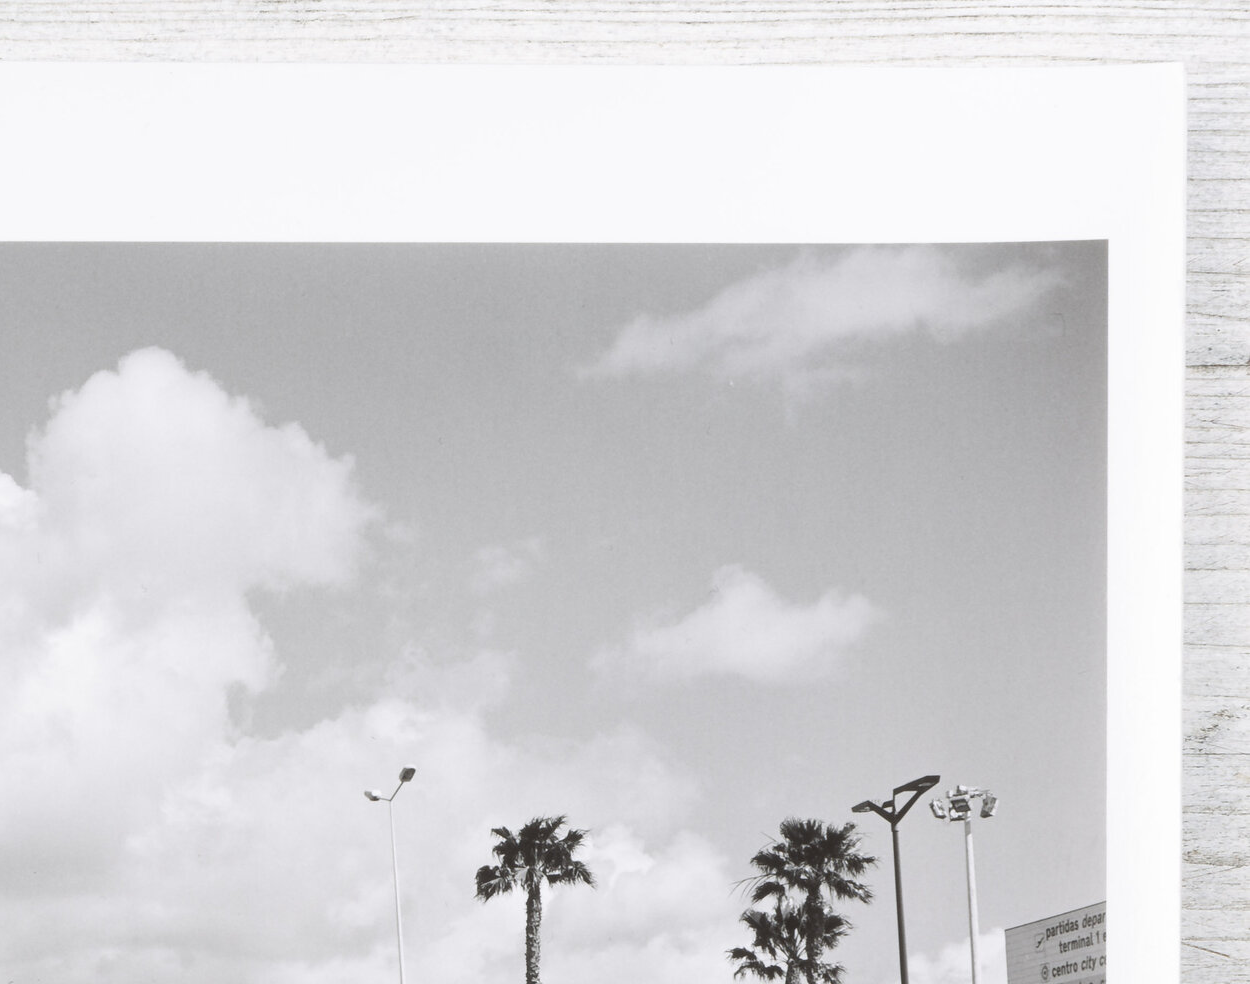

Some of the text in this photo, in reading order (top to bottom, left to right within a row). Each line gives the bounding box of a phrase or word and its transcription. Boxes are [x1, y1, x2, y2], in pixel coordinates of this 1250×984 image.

[1046, 919, 1079, 941] partidas
[1059, 932, 1093, 953] terminal
[1096, 931, 1100, 944] 1
[1052, 961, 1078, 977] centro
[1081, 956, 1097, 971] city
